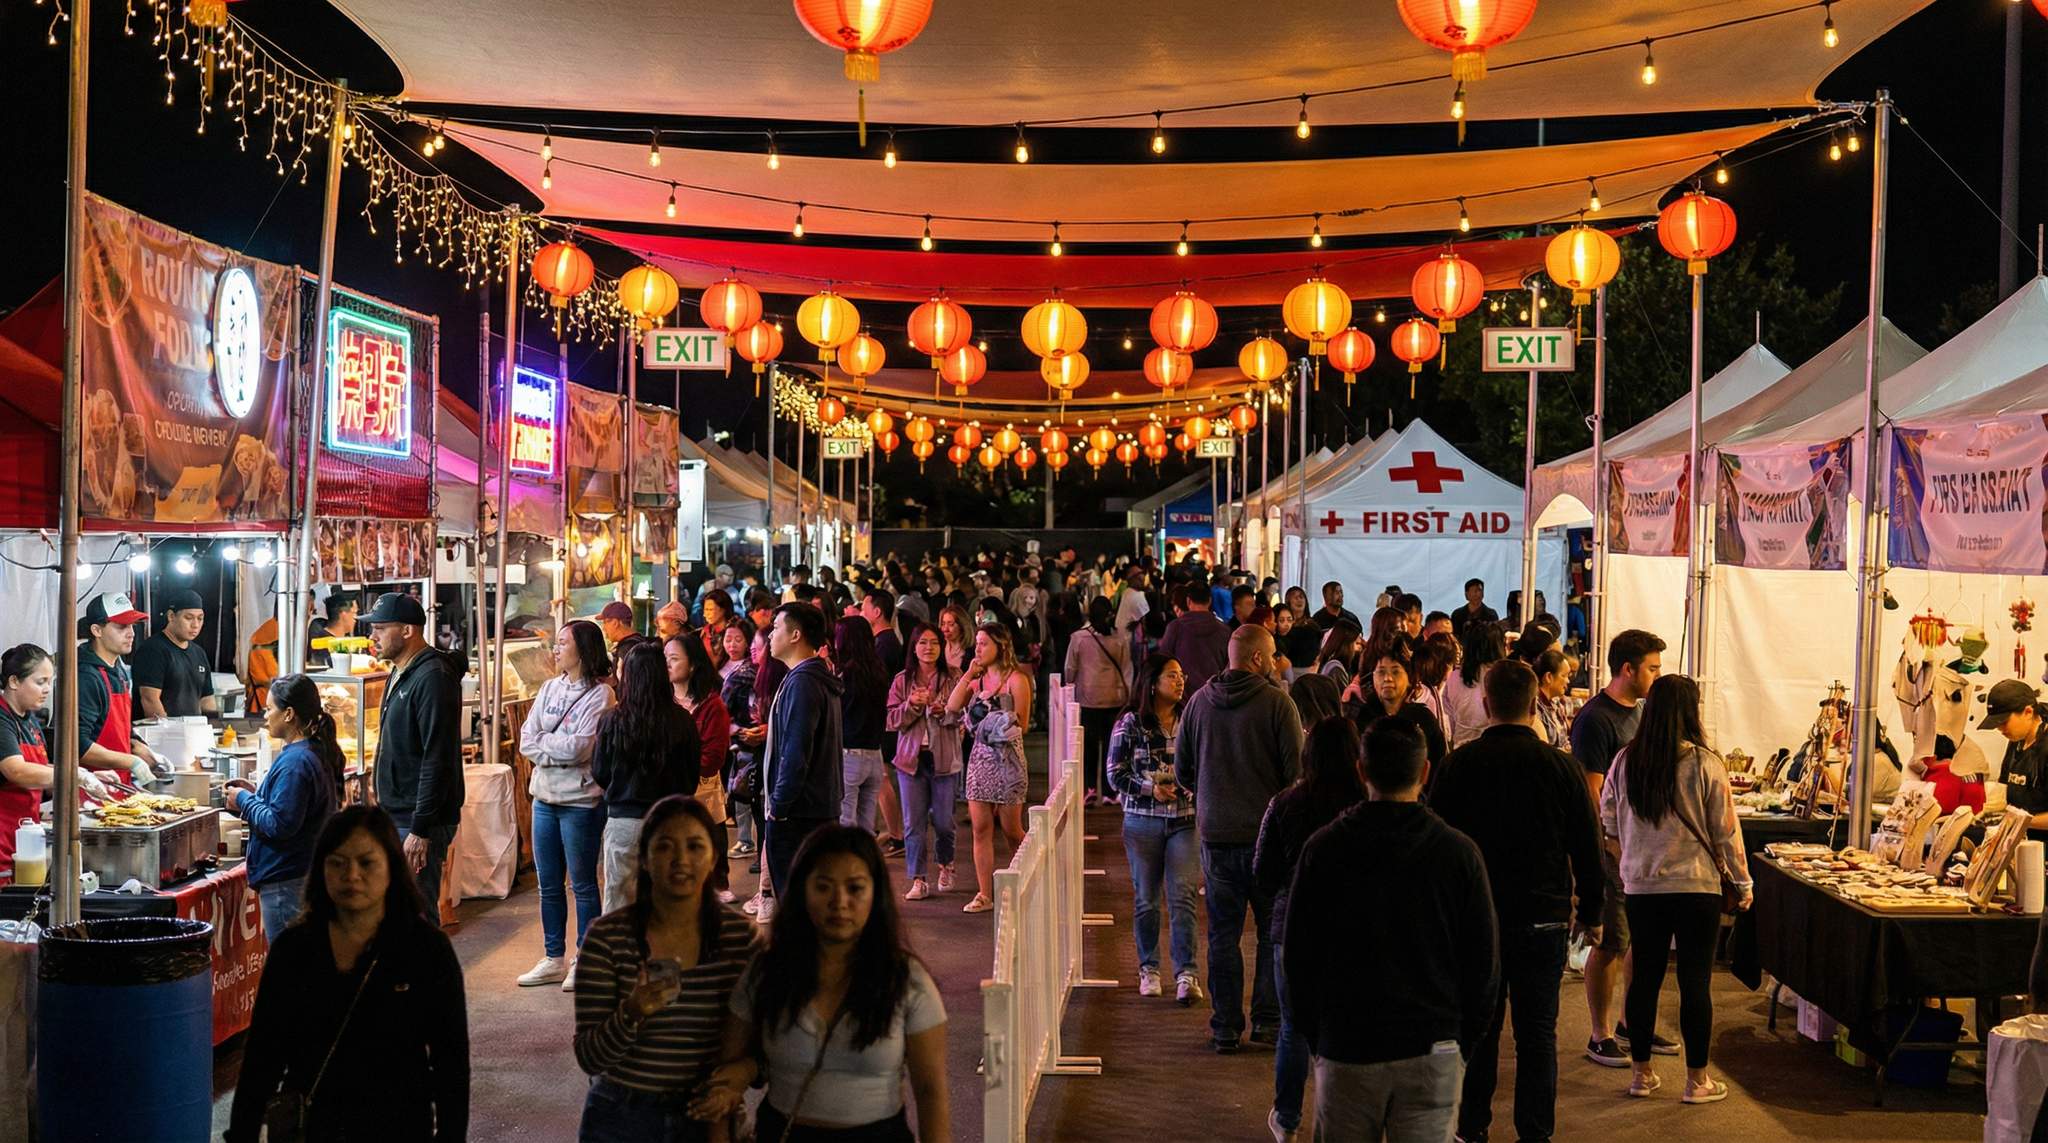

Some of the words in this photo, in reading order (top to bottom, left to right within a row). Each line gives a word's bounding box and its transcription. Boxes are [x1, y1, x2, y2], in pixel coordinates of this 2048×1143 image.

[656, 335, 717, 362] EXIT
[1497, 336, 1562, 363] EXIT
[828, 441, 858, 455] EXIT
[1202, 440, 1231, 454] EXIT
[1363, 511, 1449, 534] FIRST
[1458, 511, 1511, 534] AID
